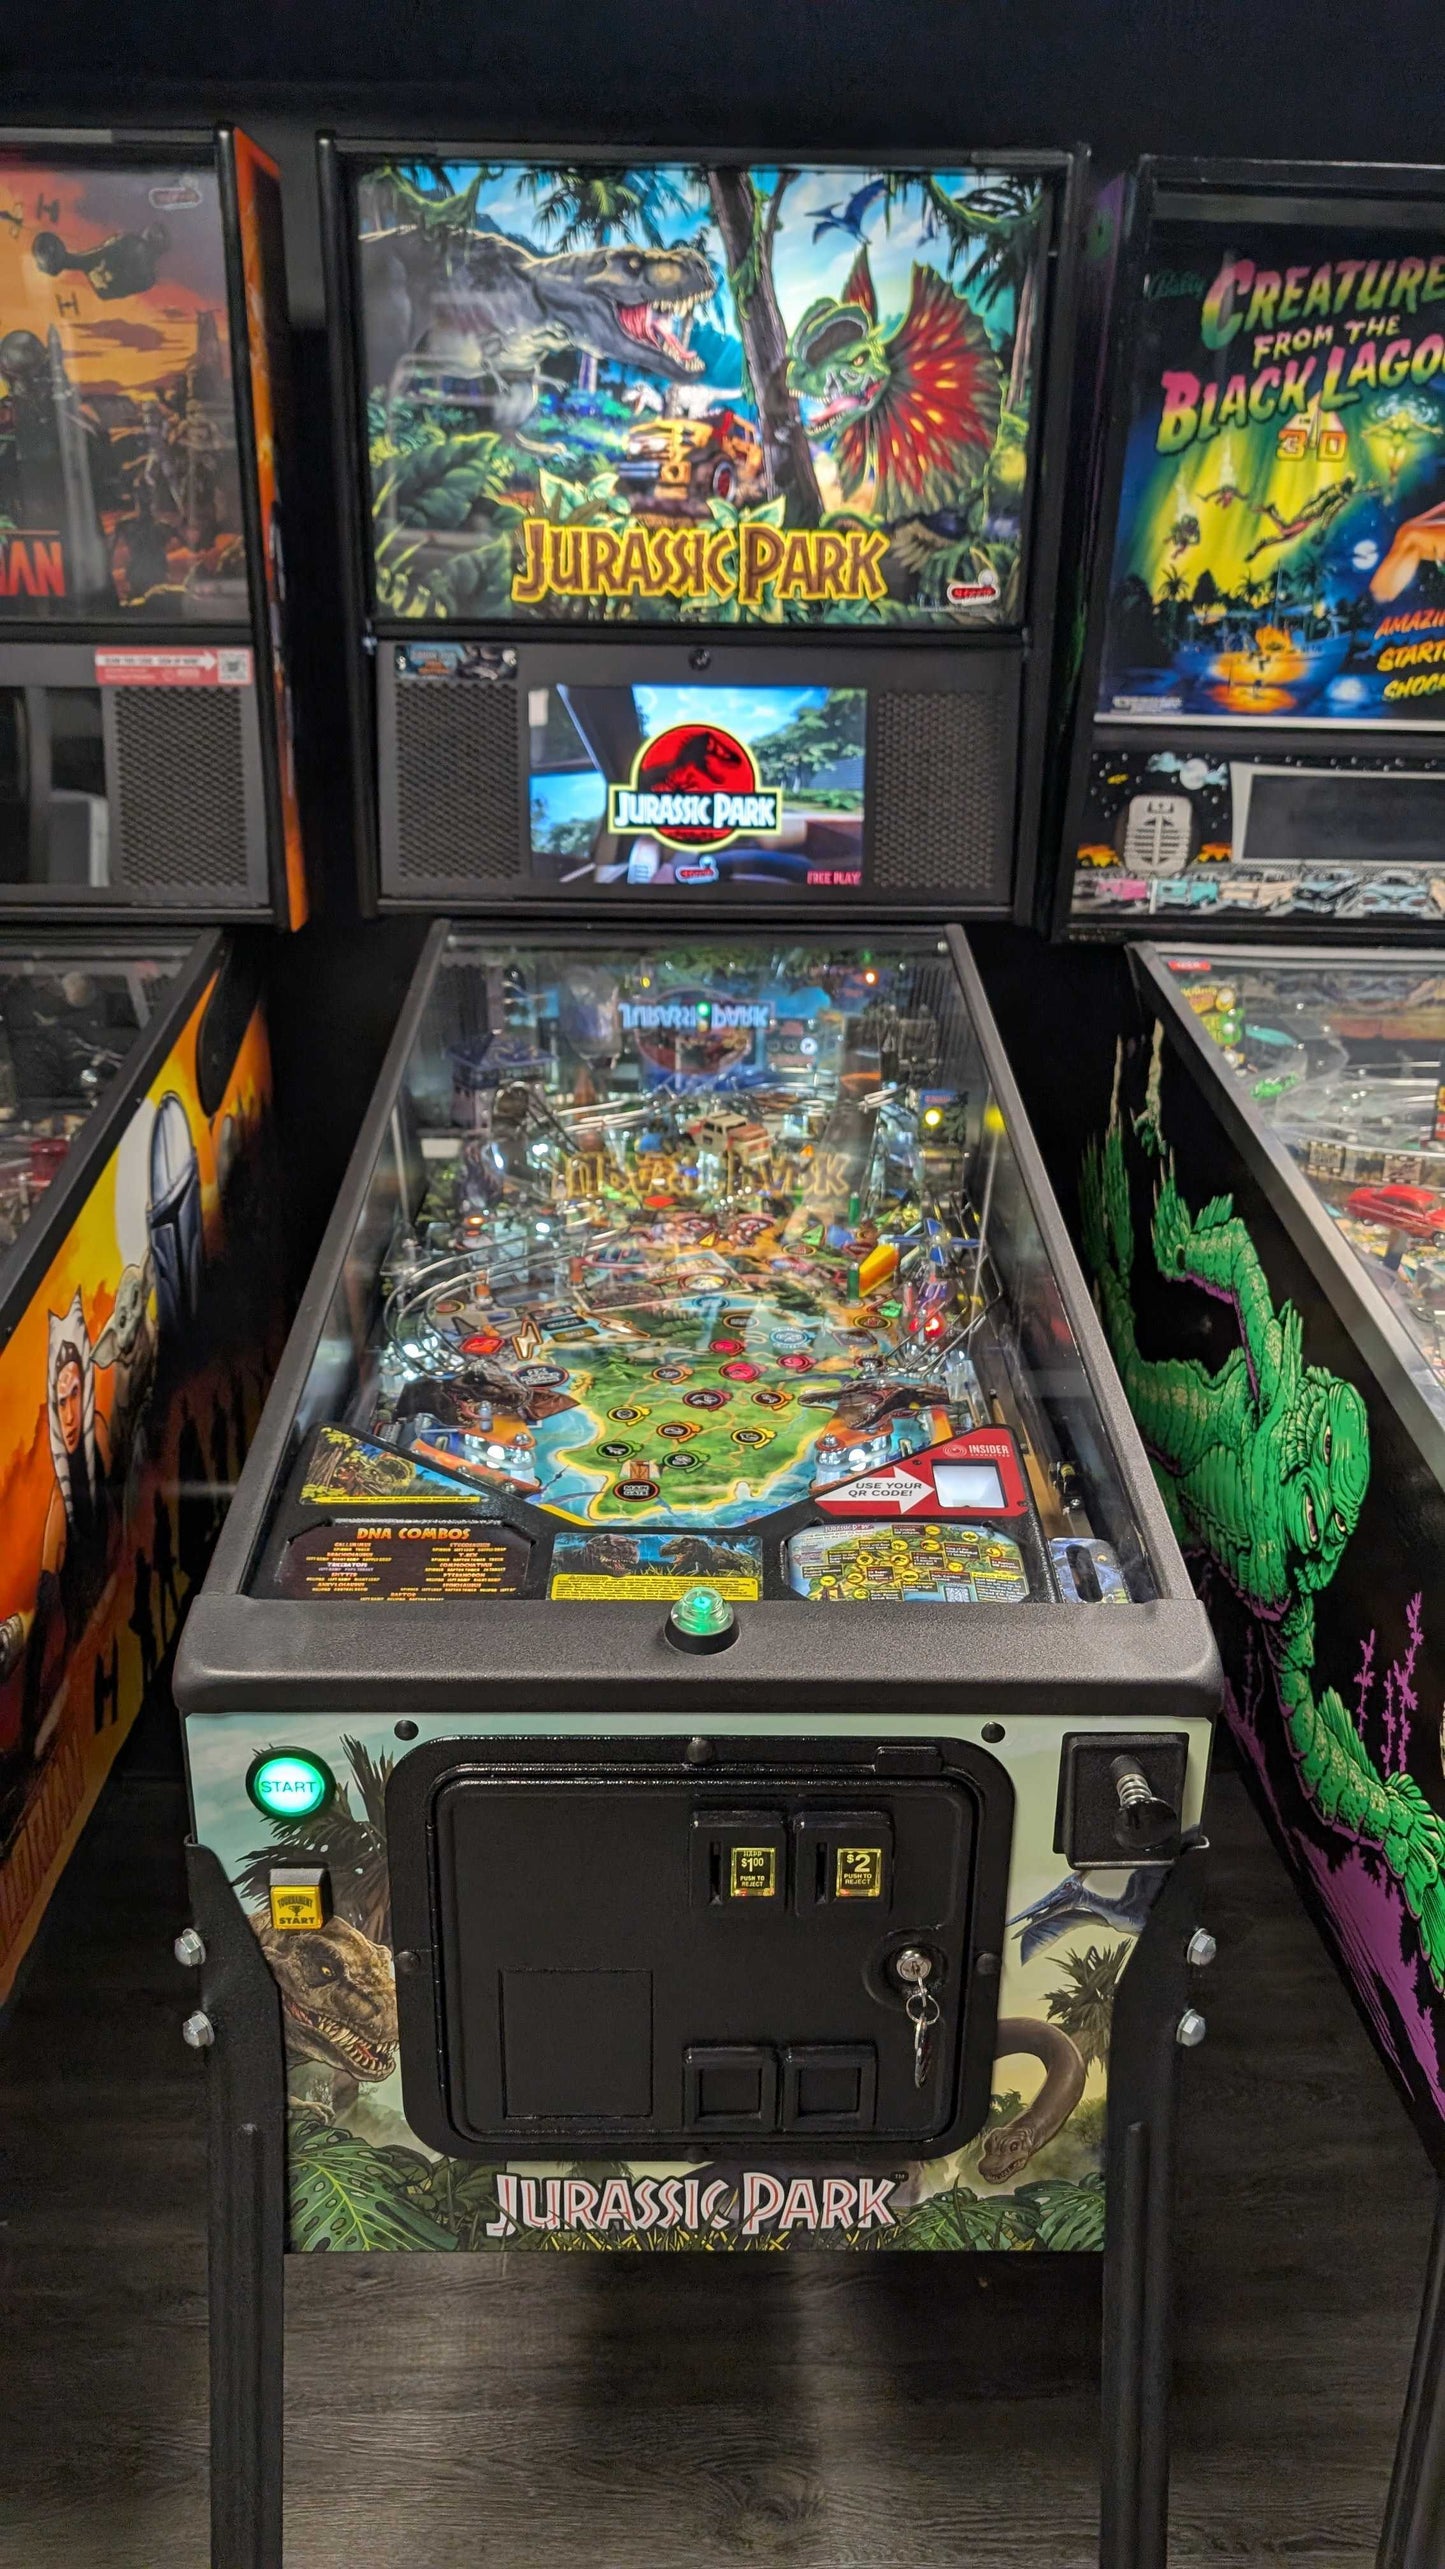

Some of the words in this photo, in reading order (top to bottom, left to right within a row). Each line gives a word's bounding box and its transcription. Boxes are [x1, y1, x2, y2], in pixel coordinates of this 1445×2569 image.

[1201, 257, 1445, 349] CREATURE
[1253, 324, 1334, 369] FROM
[1345, 314, 1401, 344] THE
[1155, 356, 1317, 452] BLACK
[1319, 333, 1445, 412] LAGO
[511, 518, 738, 602] JURASSIC
[738, 521, 890, 604] PARK
[1376, 639, 1445, 672] START
[614, 791, 711, 827] JURASSIC
[712, 792, 776, 829] PARK
[807, 871, 832, 885] FREE
[833, 871, 861, 886] PLAY
[968, 1444, 1010, 1454] INSIDER
[848, 1489, 868, 1498] QR
[871, 1489, 913, 1497] CODE!
[855, 1482, 882, 1490] USE
[886, 1482, 922, 1490] YOUR
[356, 1527, 392, 1540] DNA
[398, 1527, 471, 1540] COMBOS
[261, 1780, 318, 1793] START
[846, 1854, 871, 1873] $2
[277, 1895, 313, 1909] TOURNAMENT
[279, 1916, 315, 1925] START
[486, 2173, 731, 2238] JURASSIC
[740, 2172, 898, 2235] PARK
